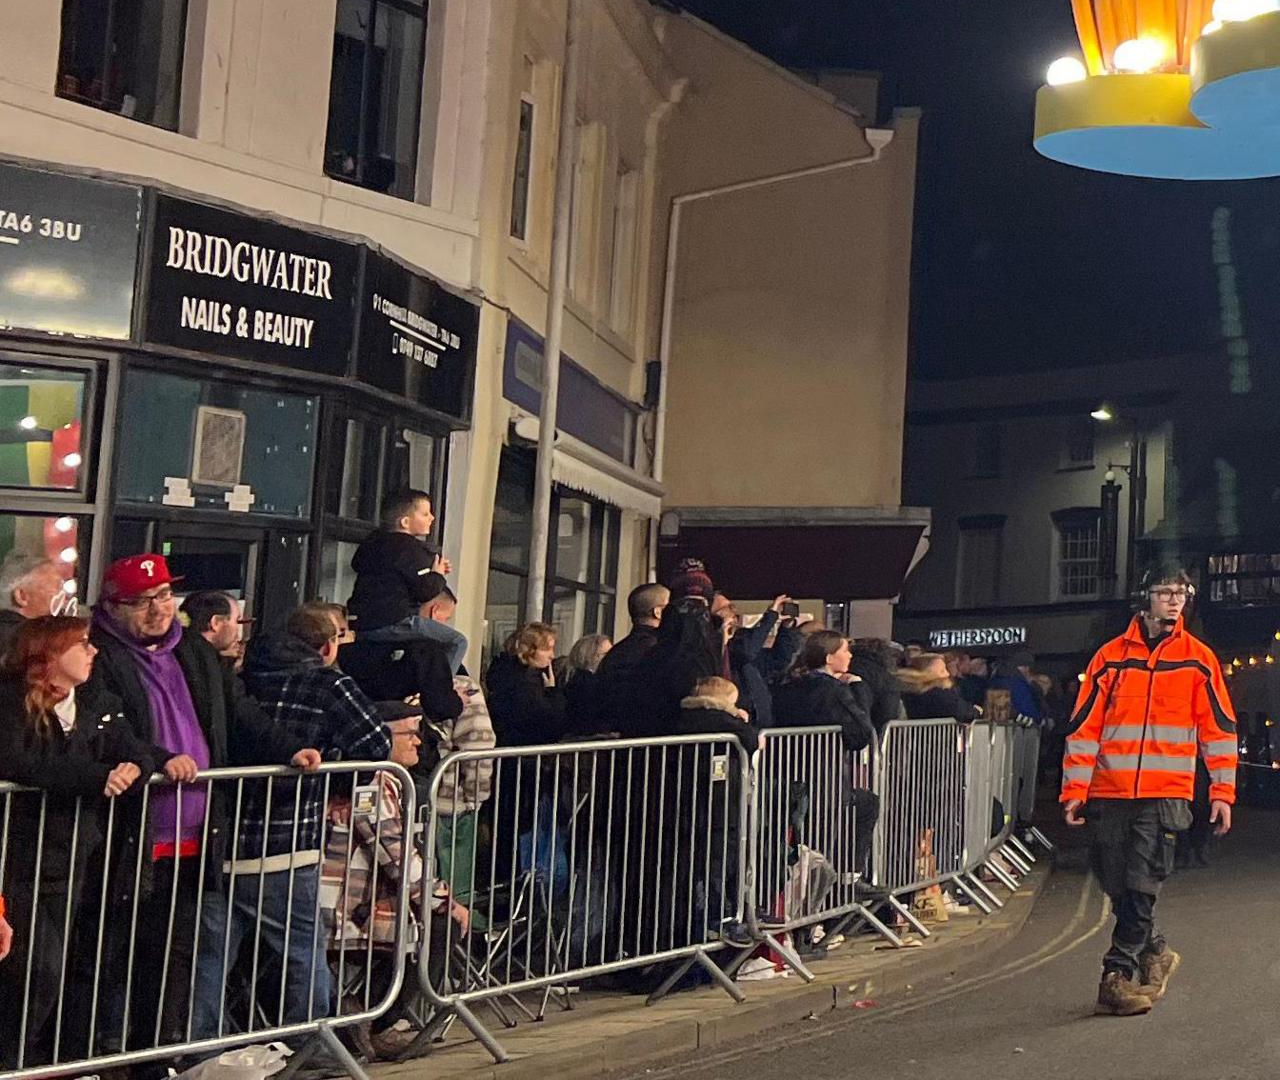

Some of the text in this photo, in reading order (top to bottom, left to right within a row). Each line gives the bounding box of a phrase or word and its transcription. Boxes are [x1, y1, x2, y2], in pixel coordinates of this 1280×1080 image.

[40, 218, 81, 241] 3BU
[166, 226, 333, 300] BRIDGWATER
[181, 296, 314, 349] NAILS & BEAUTY
[140, 560, 155, 577] P
[929, 627, 1026, 647] WETHERSPOON
